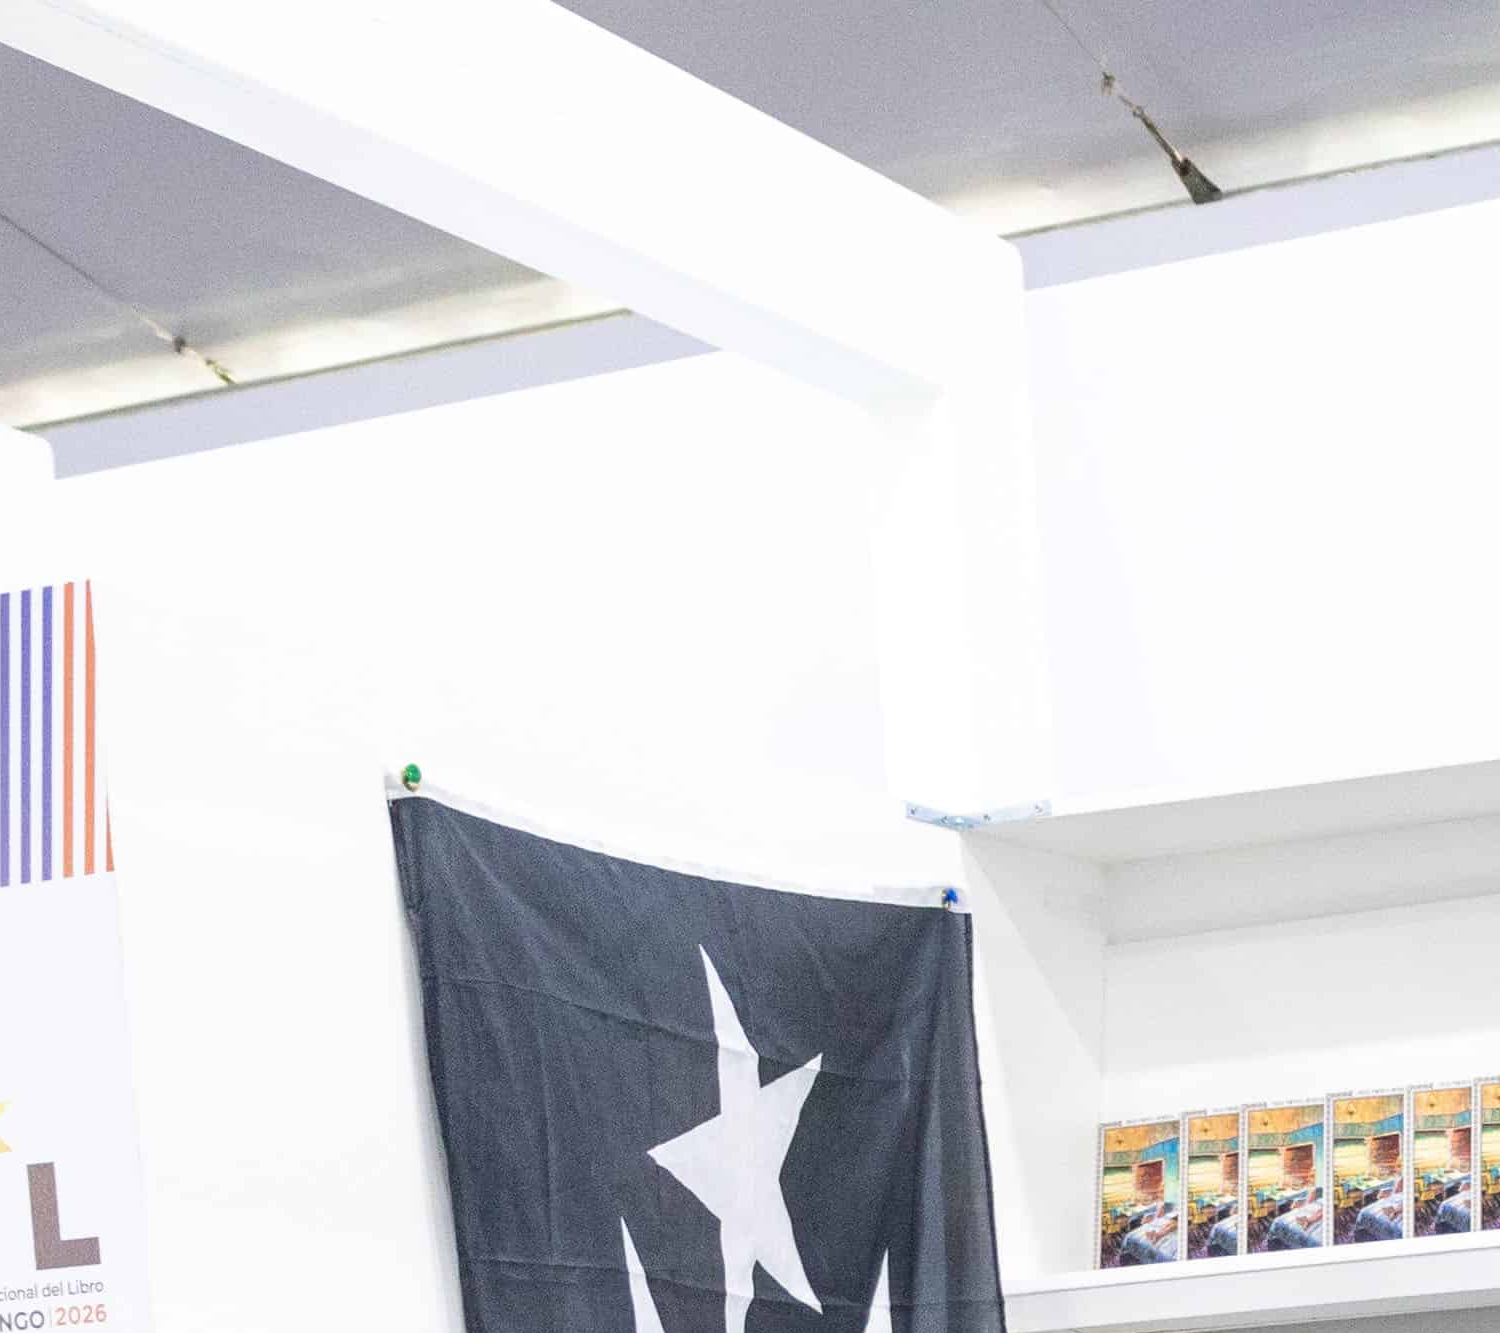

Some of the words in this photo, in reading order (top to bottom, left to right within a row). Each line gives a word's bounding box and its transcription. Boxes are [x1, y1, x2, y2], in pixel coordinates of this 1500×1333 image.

[42, 1281, 64, 1298] del
[67, 1279, 104, 1296] Libro
[54, 1304, 108, 1327] 2026
